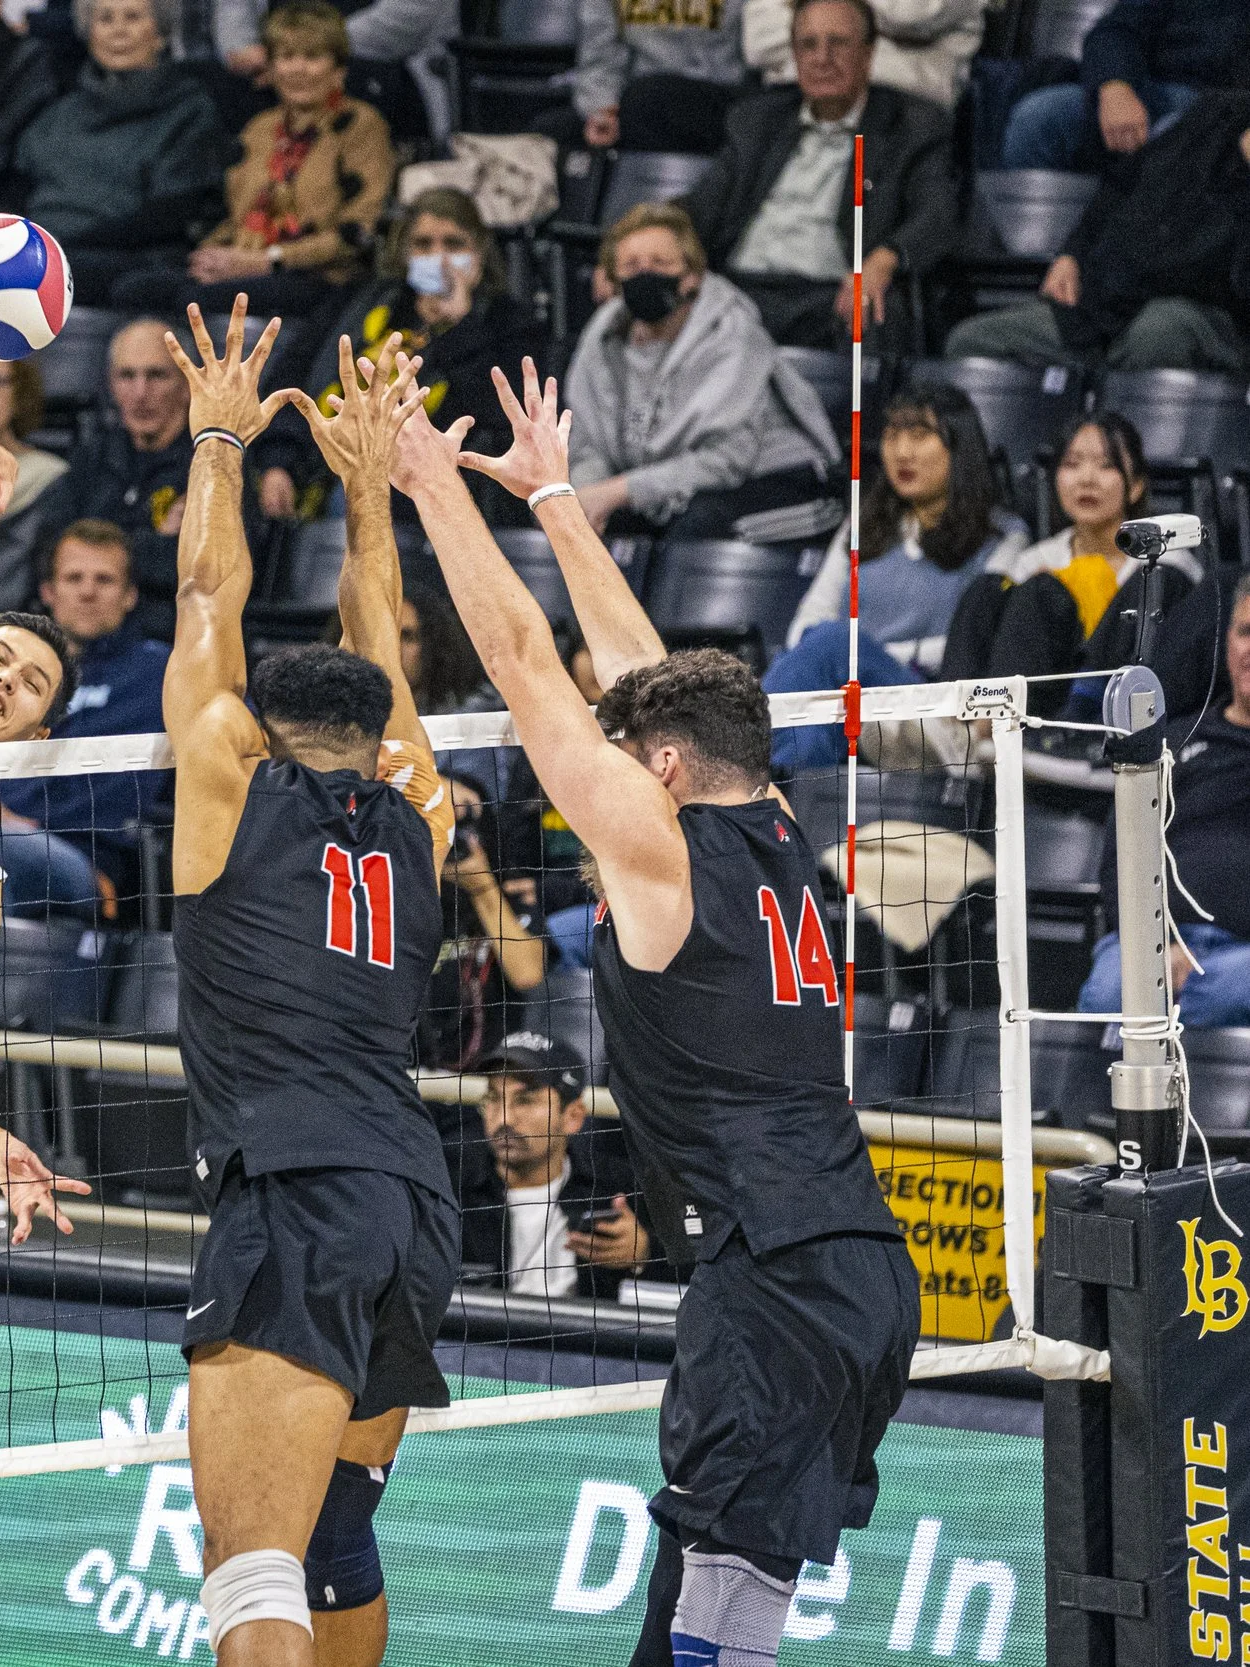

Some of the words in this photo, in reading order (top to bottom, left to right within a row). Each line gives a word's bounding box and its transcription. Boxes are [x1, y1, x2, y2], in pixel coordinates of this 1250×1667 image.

[981, 685, 1009, 697] Senoh
[320, 842, 395, 971] 11
[757, 884, 839, 1007] 14
[685, 1204, 698, 1216] XL
[1119, 1140, 1142, 1170] S
[1176, 1216, 1250, 1340] LB
[887, 1517, 1017, 1663] In
[1184, 1417, 1231, 1662] STATE
